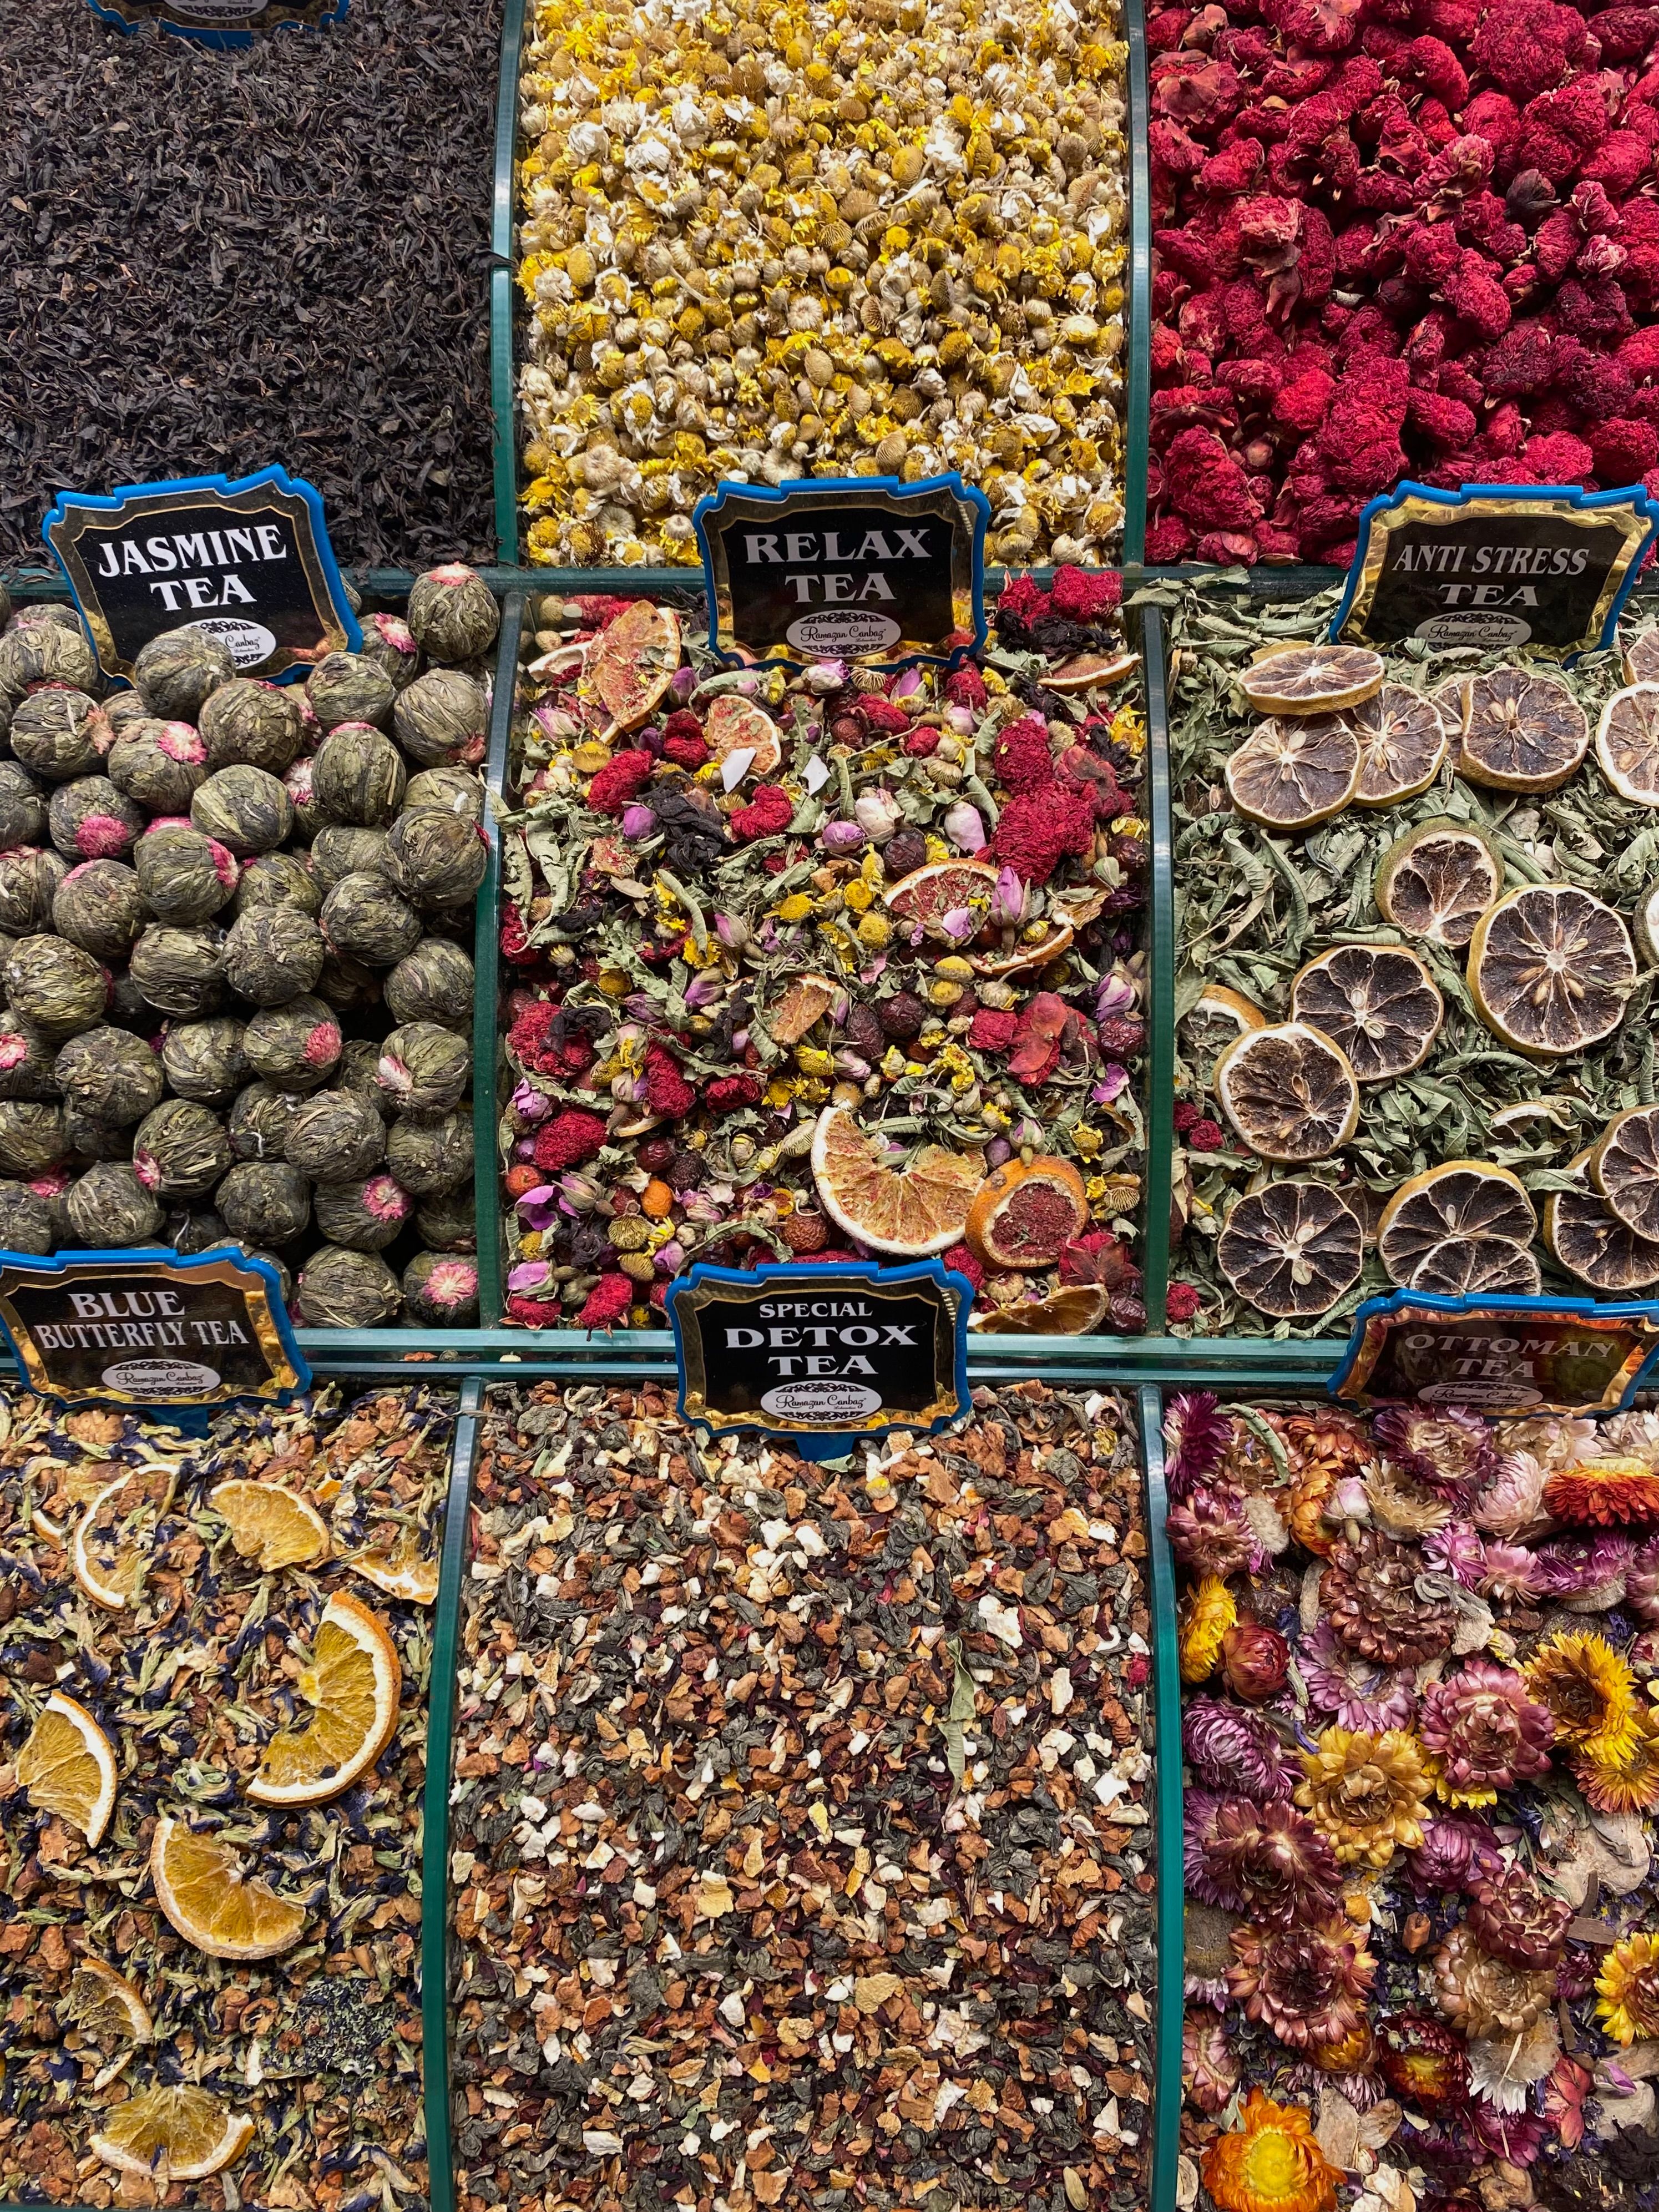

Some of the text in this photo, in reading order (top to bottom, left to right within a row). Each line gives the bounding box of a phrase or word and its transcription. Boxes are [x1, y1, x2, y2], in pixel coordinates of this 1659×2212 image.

[98, 524, 287, 577] JASMINE
[743, 529, 933, 563] RELAX
[1392, 544, 1590, 575] ANTI STRESS
[150, 574, 257, 611] TEA
[784, 573, 897, 603] TEA
[1438, 583, 1540, 607] TEA
[225, 634, 260, 650] Canbaz
[800, 625, 884, 643] Ramazan Canbaz
[1428, 624, 1516, 642] Ramazan Canbaz
[67, 1291, 185, 1319] BLUE
[759, 1302, 873, 1319] SPECIAL
[33, 1320, 250, 1350] BUTTERFLY TEA
[724, 1325, 919, 1349] DETOX
[1404, 1334, 1617, 1358] OTTOMAN
[767, 1355, 879, 1376] TEA
[1454, 1357, 1535, 1378] TEA
[115, 1371, 203, 1385] Ramazan Canbaz
[776, 1394, 864, 1409] Ramazan Canbaz
